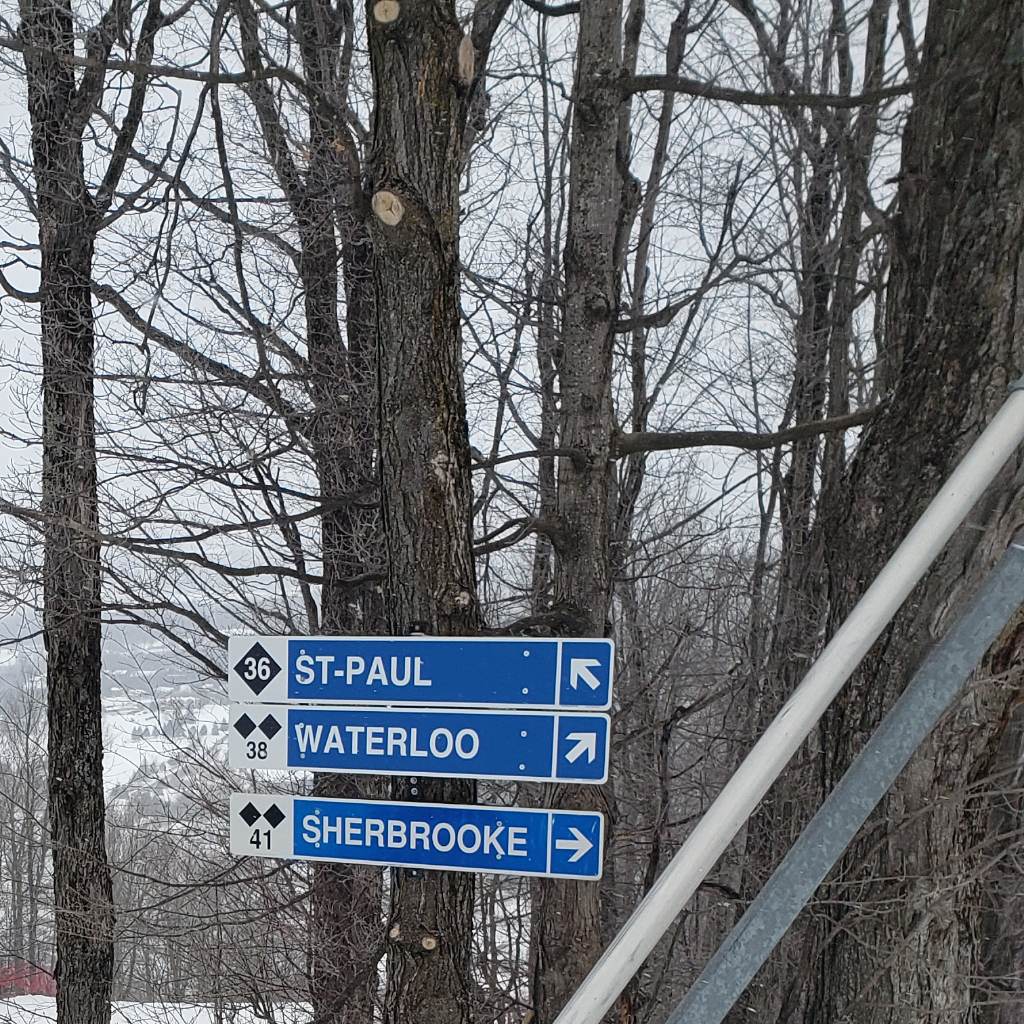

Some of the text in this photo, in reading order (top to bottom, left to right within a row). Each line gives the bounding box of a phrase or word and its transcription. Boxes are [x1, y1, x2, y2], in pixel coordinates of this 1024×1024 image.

[244, 655, 432, 687] 36 ST-PAUL
[246, 724, 480, 759] 38 WATERLOO
[249, 814, 527, 857] 41 SHERBROOKE
